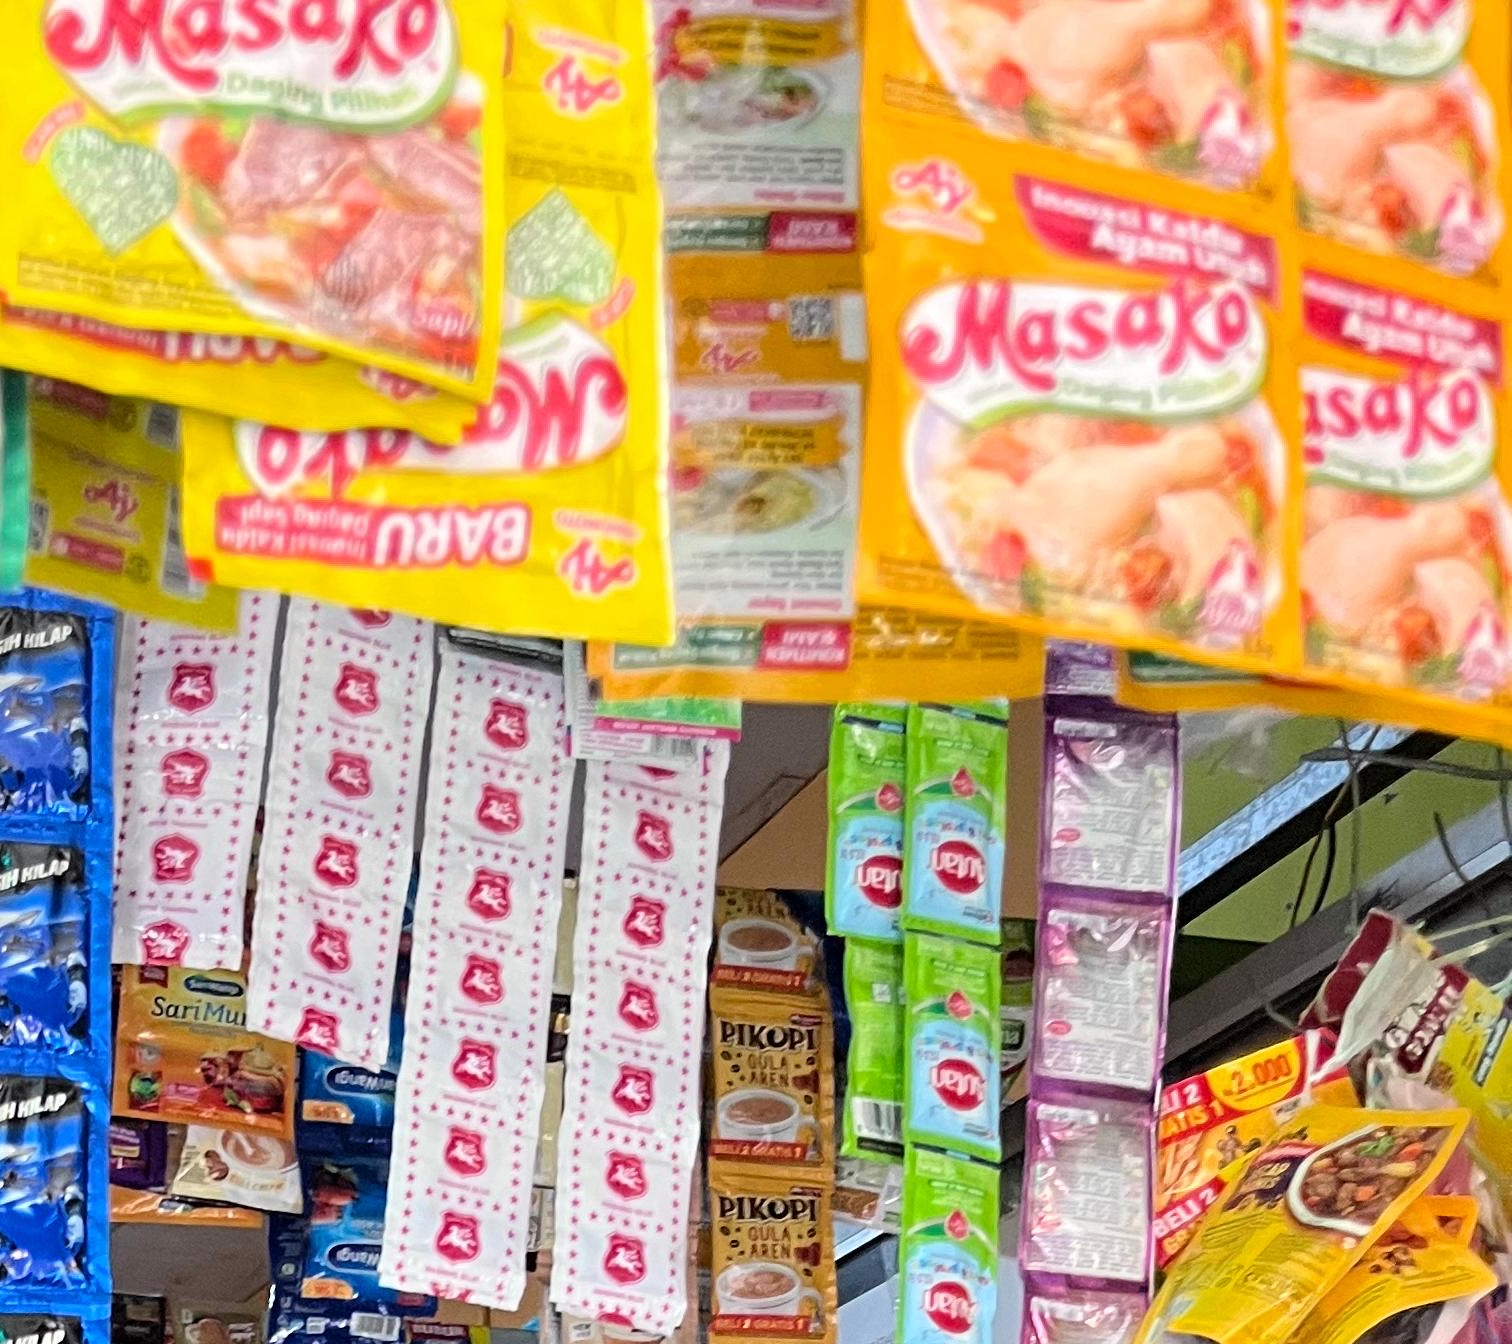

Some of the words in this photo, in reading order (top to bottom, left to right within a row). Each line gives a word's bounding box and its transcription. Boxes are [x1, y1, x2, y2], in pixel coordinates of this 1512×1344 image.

[45, 0, 439, 89] Masako
[903, 277, 1250, 393] Masako
[373, 504, 529, 564] BARU
[24, 624, 73, 649] KILAP
[20, 859, 70, 883] KILAP
[719, 1020, 814, 1051] PIKOPI
[17, 1092, 67, 1118] KILAP
[718, 1196, 816, 1222] PIKOPI
